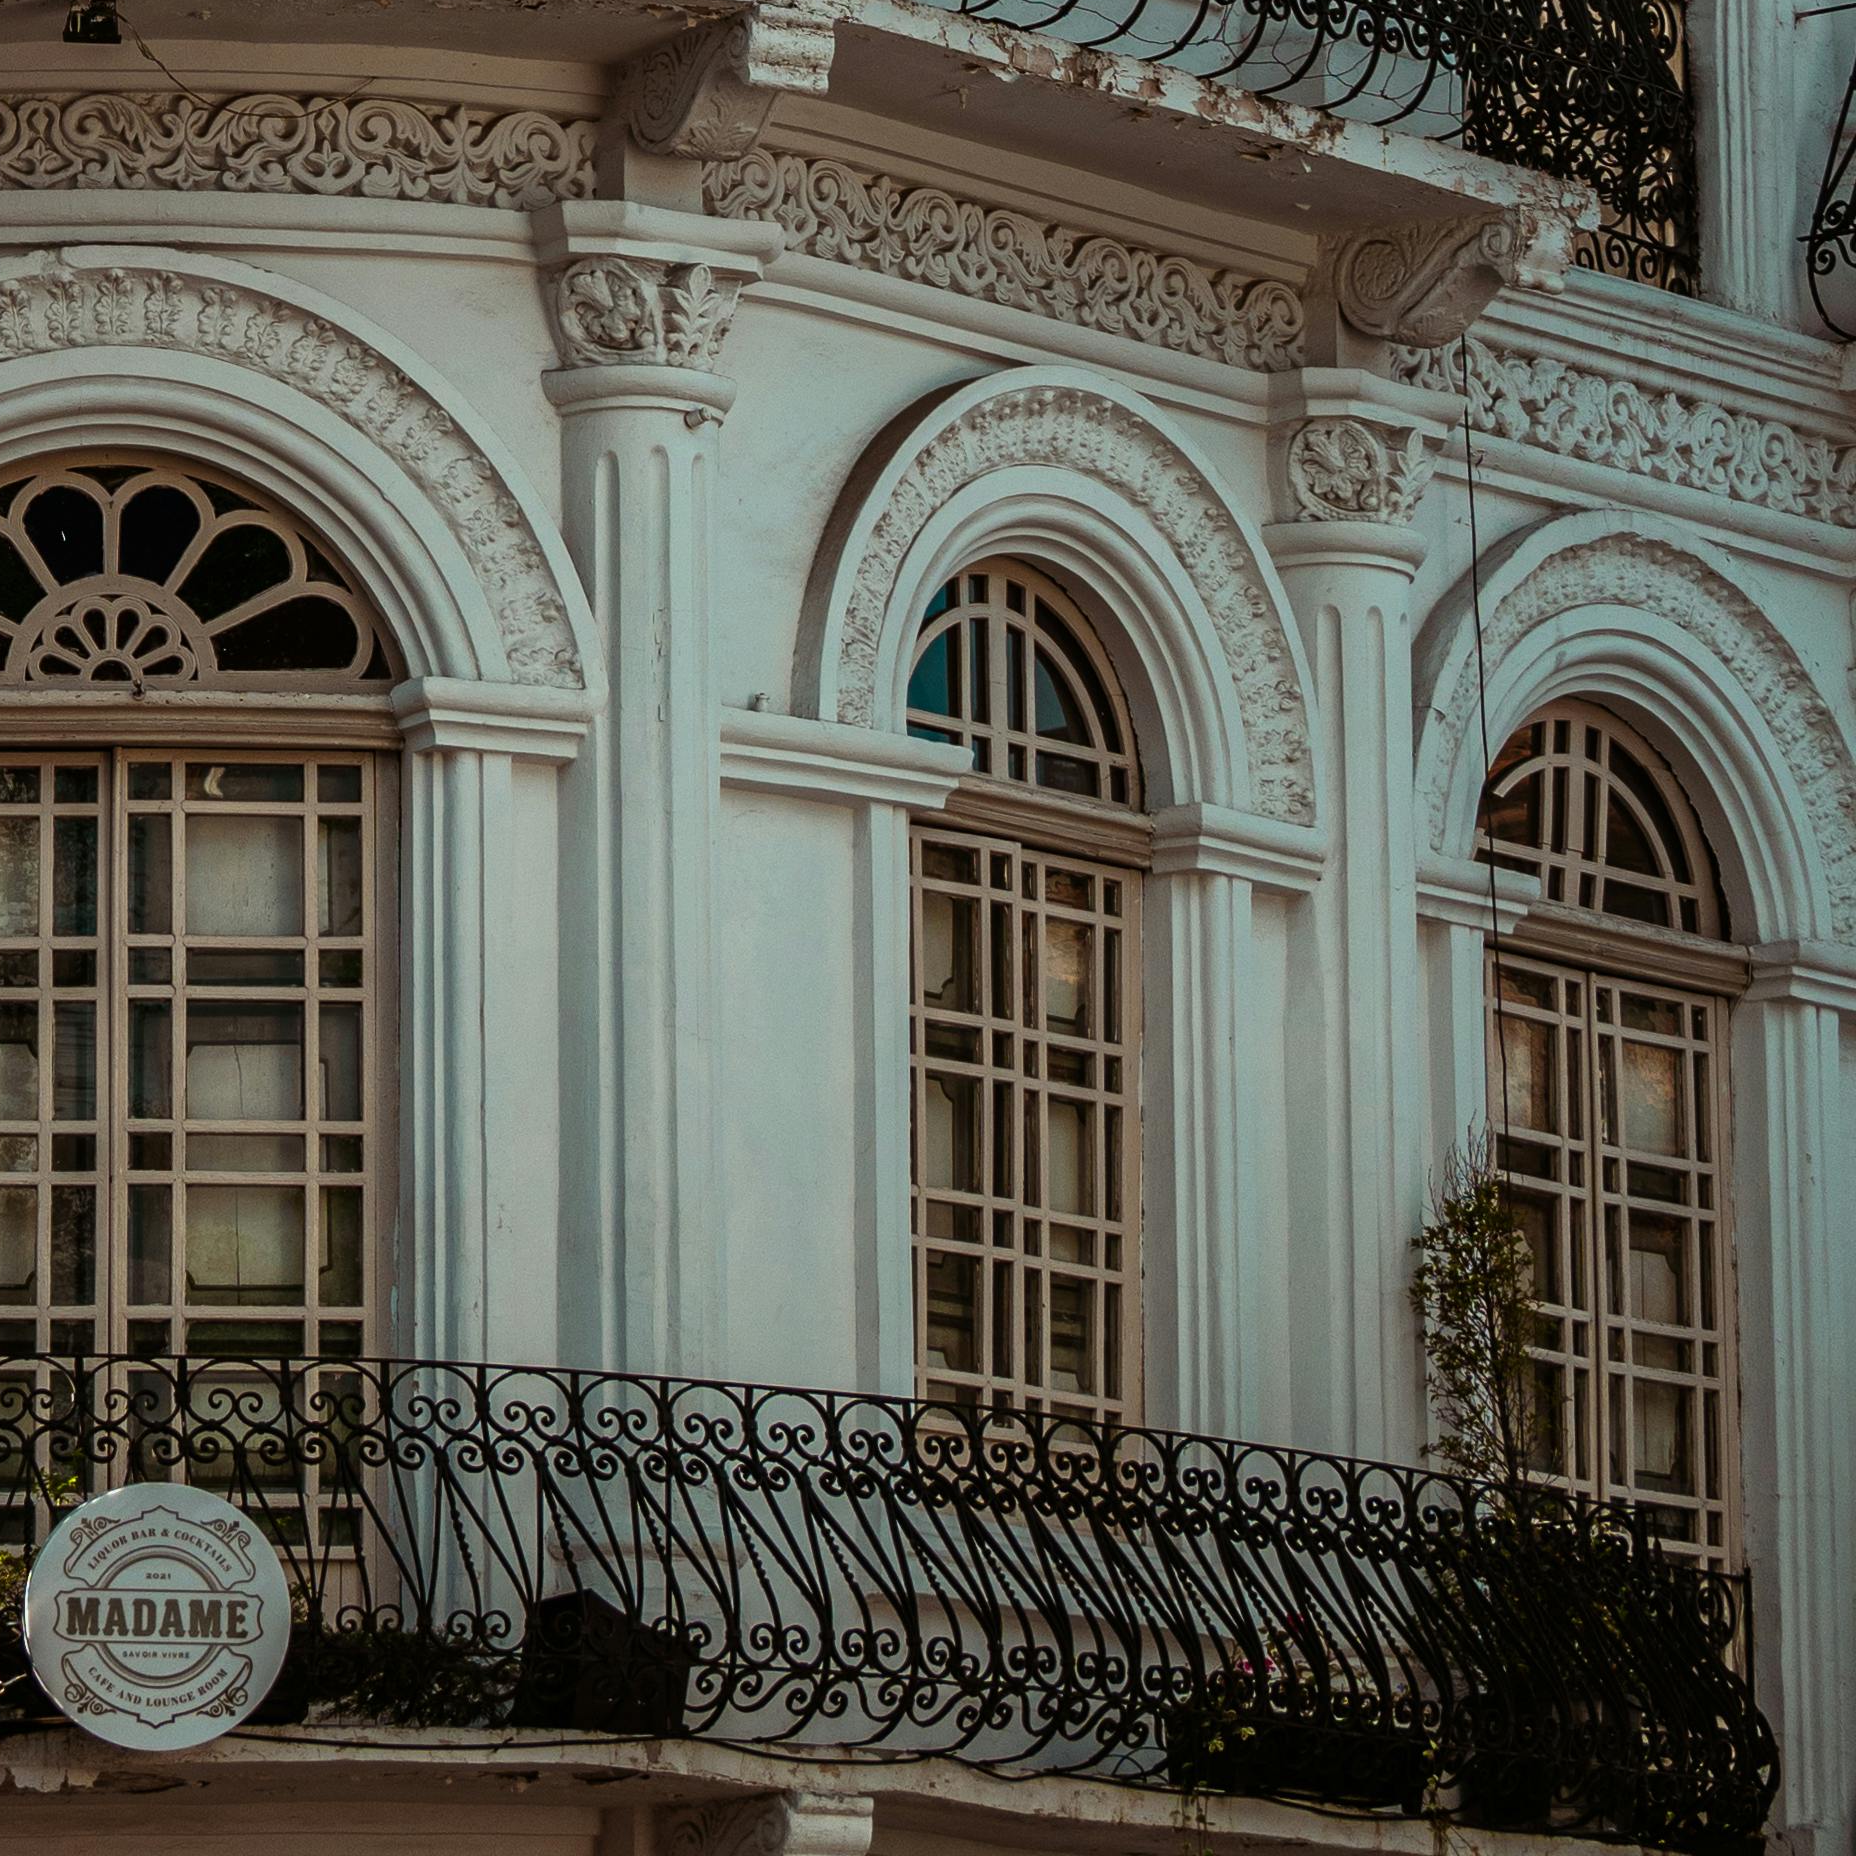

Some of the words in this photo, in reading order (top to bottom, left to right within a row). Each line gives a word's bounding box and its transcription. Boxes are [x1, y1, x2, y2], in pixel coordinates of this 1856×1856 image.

[87, 1535, 128, 1570] LIQUOR
[131, 1527, 156, 1541] BAR
[160, 1528, 170, 1537] &
[174, 1529, 233, 1572] COCKTAILS
[145, 1572, 172, 1580] 2021
[66, 1596, 249, 1639] MADAME
[122, 1650, 158, 1659] SAVOIR
[162, 1651, 190, 1659] VIVRE
[88, 1666, 113, 1693] CAFE
[115, 1689, 142, 1705] AND
[145, 1691, 196, 1707] LOUNGE
[199, 1668, 229, 1696] ROOM
